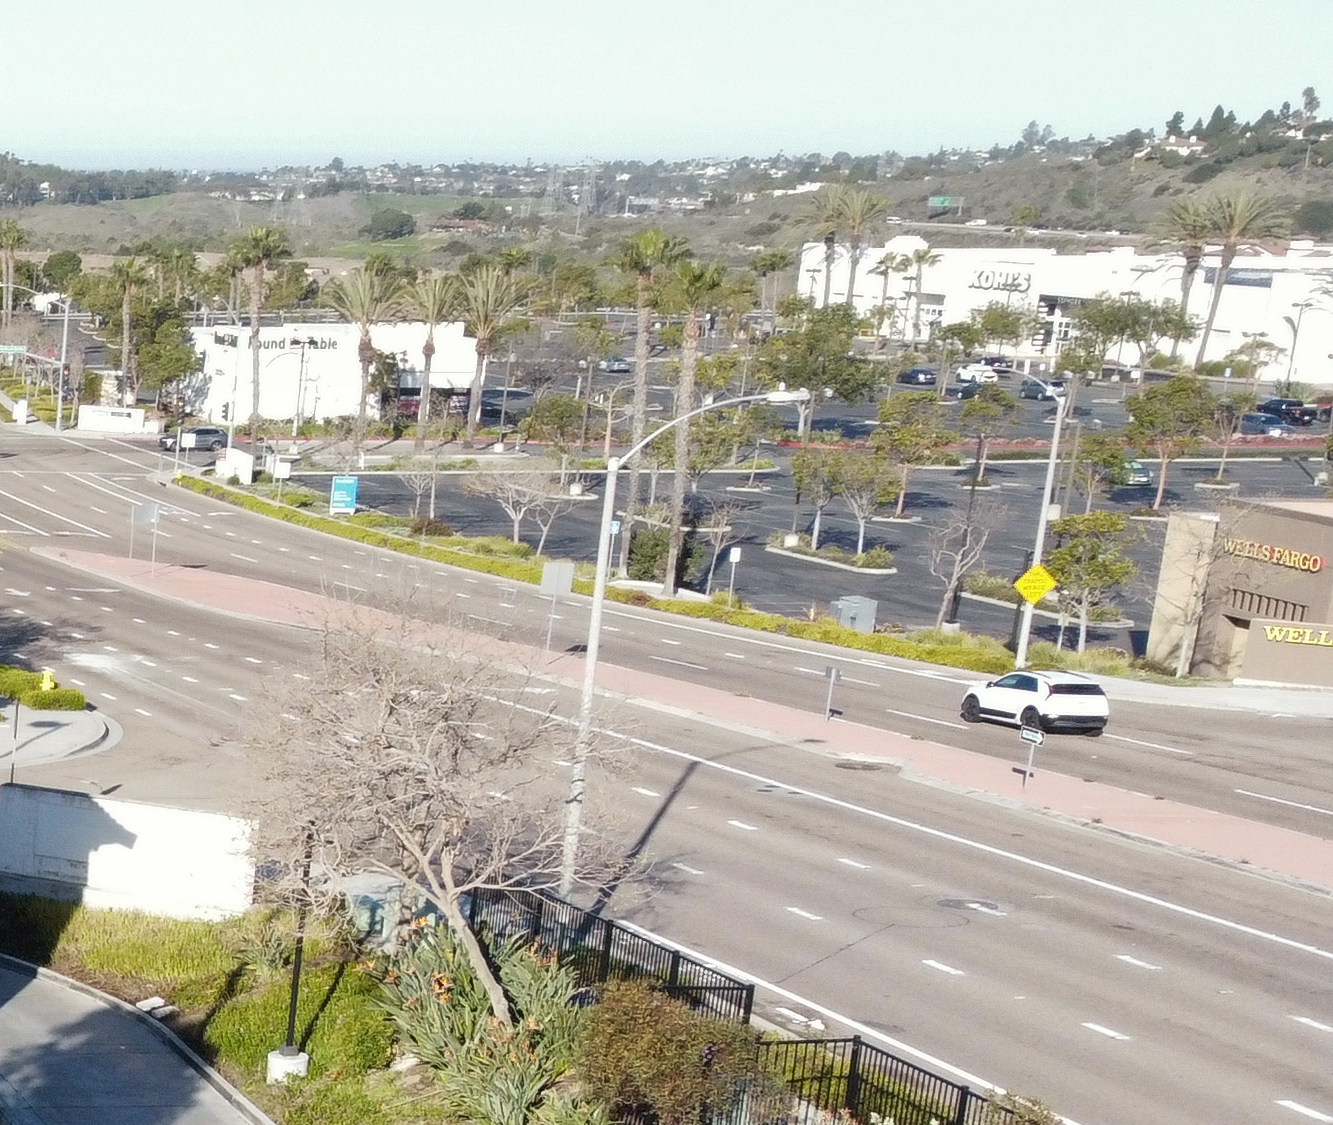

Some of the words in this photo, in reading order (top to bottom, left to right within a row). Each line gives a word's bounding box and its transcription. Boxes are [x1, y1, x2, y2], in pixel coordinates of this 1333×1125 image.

[967, 270, 1031, 293] KOHL'S
[1223, 538, 1271, 562] WELLS
[1273, 547, 1322, 573] FARGO
